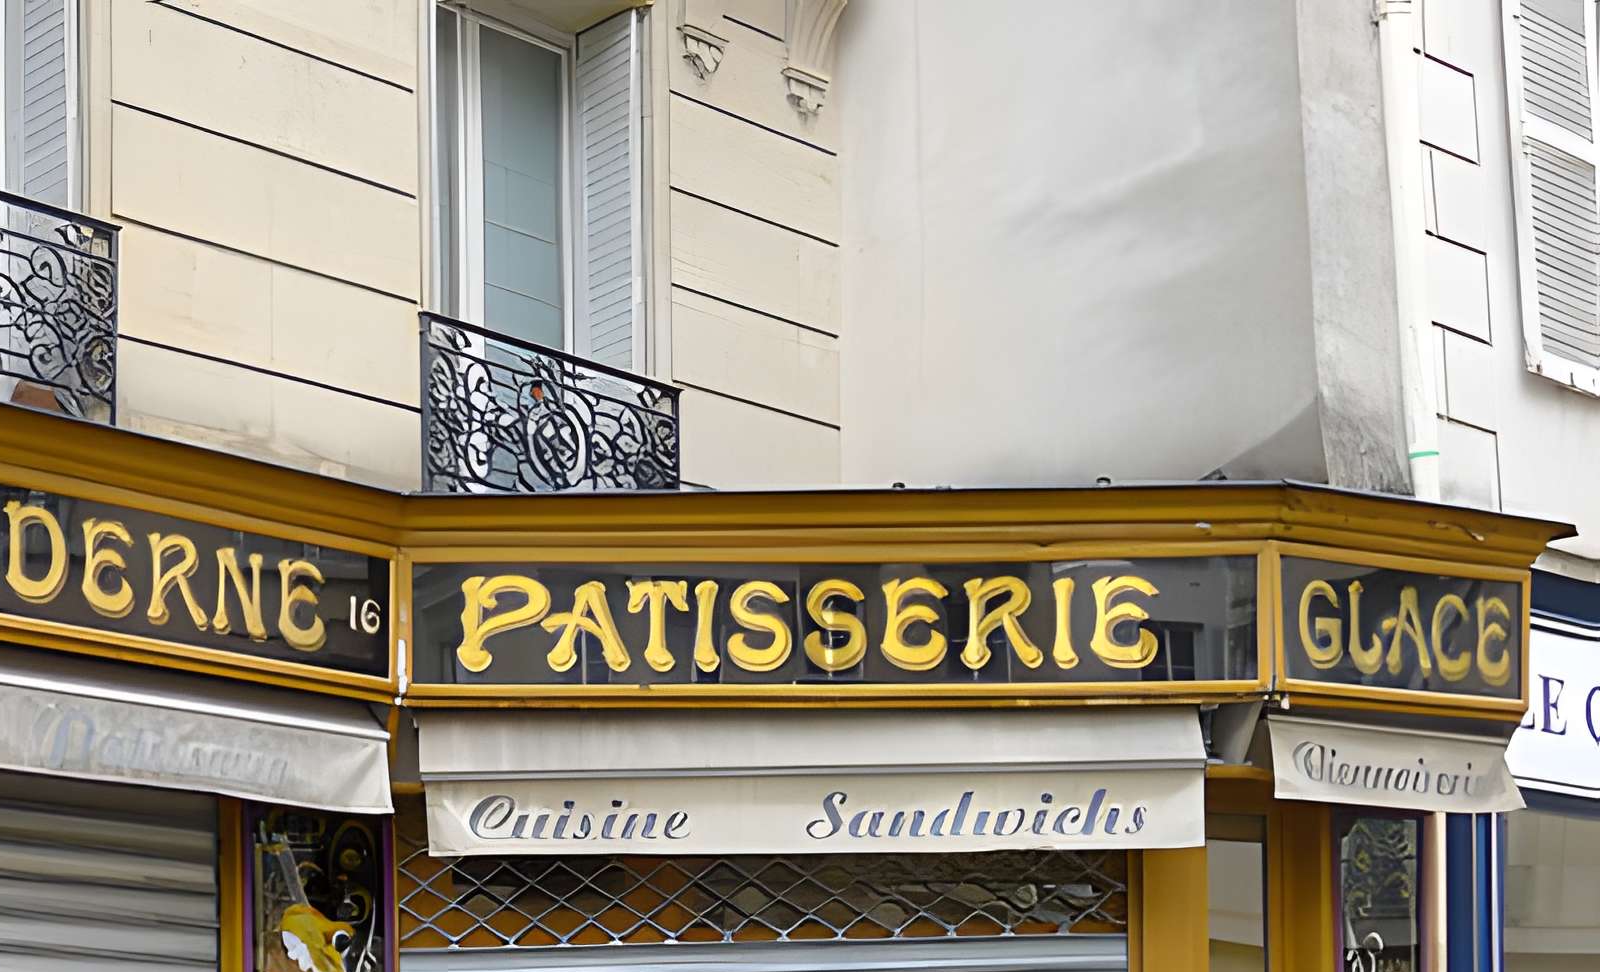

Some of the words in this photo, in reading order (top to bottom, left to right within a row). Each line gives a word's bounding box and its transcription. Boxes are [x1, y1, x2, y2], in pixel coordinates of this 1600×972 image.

[349, 595, 381, 635] 16
[457, 573, 1160, 675] PATISSERIE
[1299, 578, 1512, 687] GLACE
[469, 794, 691, 841] Cuisine
[806, 788, 1148, 840] Sandwichs
